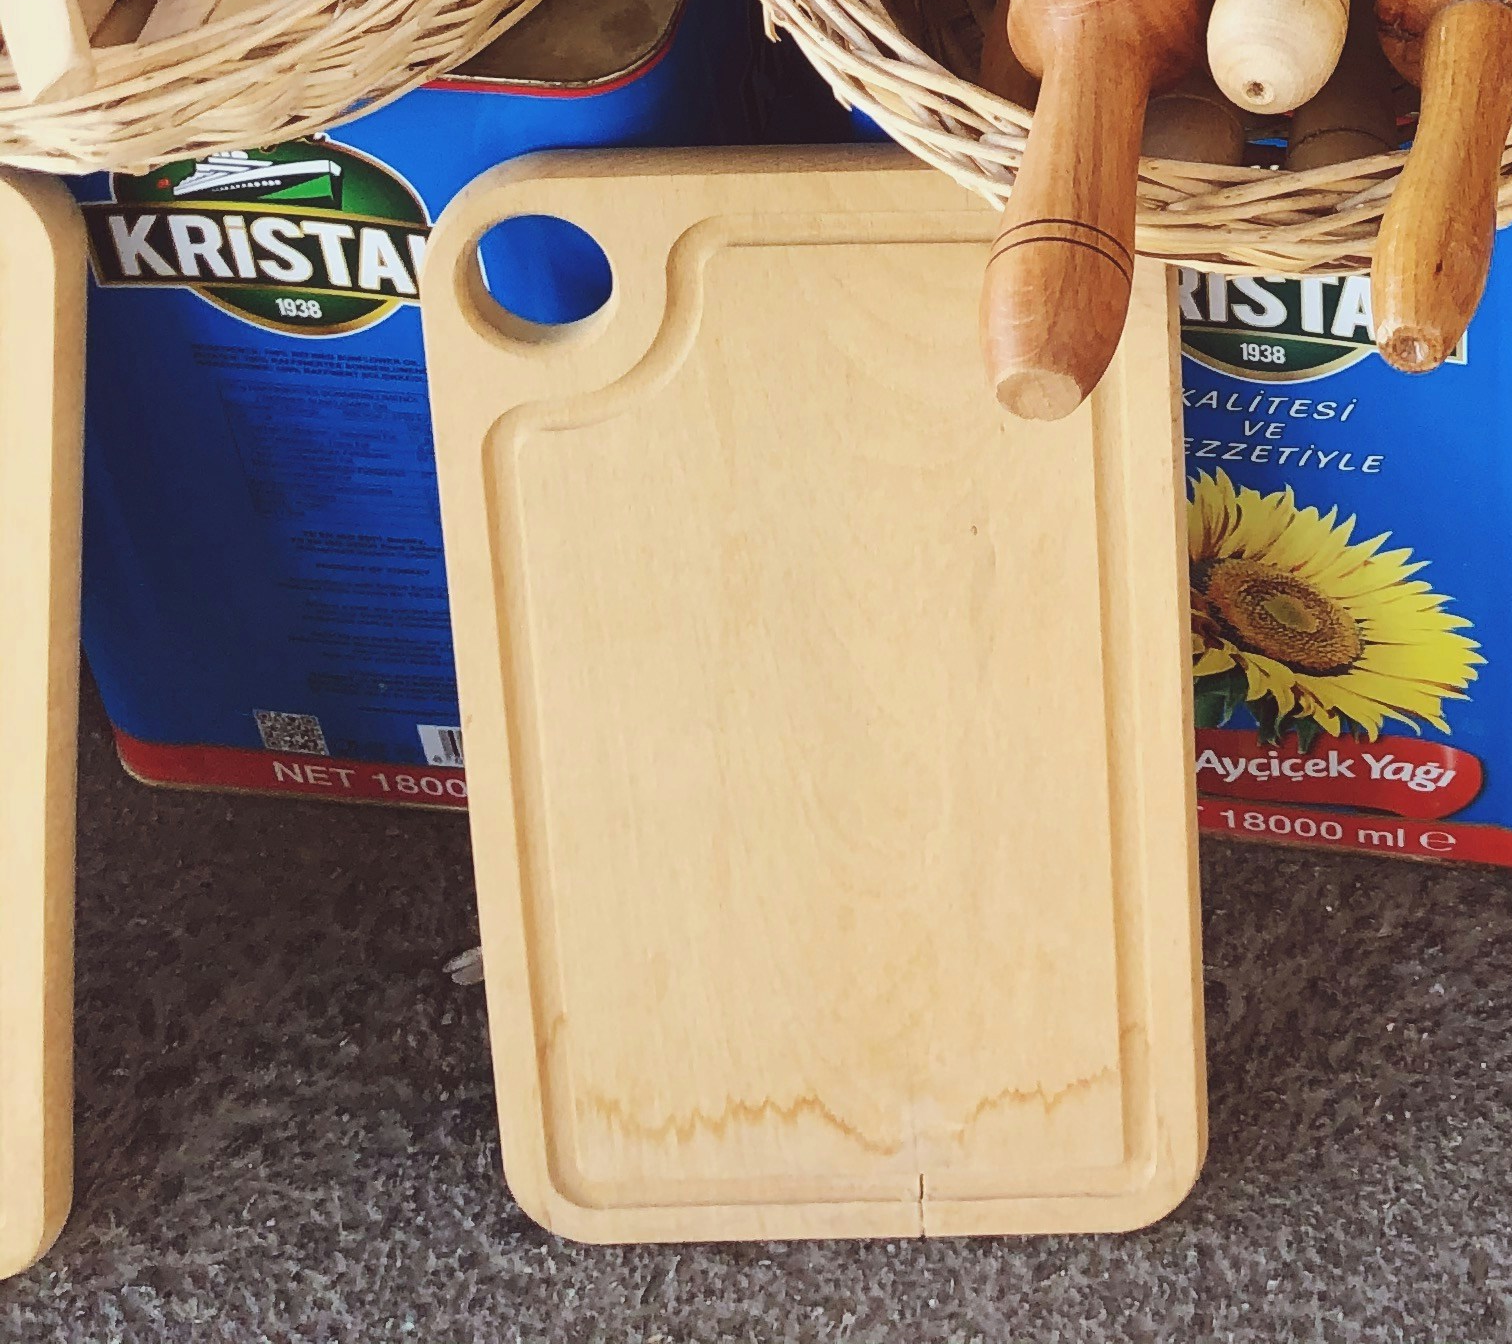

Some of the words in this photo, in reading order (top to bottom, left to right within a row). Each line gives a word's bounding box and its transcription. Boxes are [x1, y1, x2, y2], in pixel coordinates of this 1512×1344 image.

[275, 297, 323, 319] 1938
[1179, 266, 1376, 342] RISTA
[1240, 342, 1286, 365] 1938
[1244, 420, 1286, 439] VE
[1184, 437, 1385, 474] ZZETİYLE
[272, 760, 356, 789] NET
[372, 772, 468, 798] 1800
[1196, 749, 1356, 783] Ayçiçek
[1361, 752, 1457, 792] Yağı
[1219, 809, 1343, 841] 18000
[1357, 828, 1405, 848] ml
